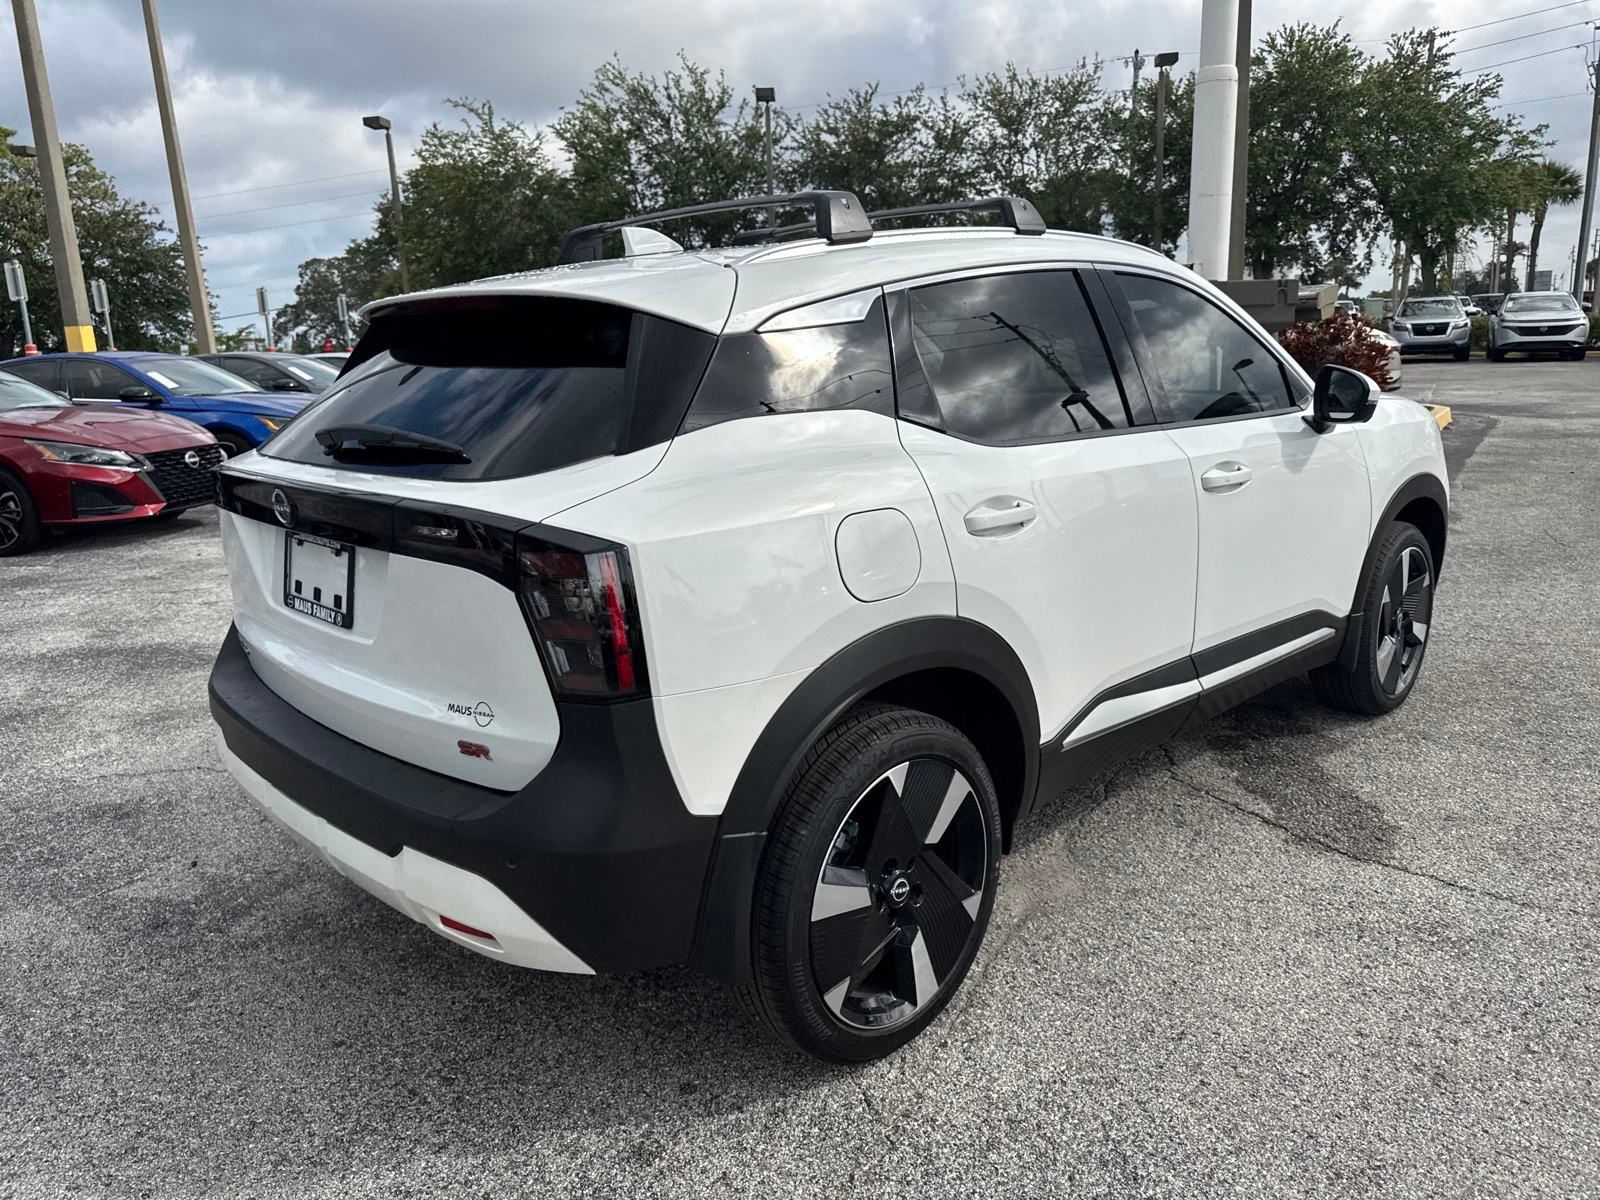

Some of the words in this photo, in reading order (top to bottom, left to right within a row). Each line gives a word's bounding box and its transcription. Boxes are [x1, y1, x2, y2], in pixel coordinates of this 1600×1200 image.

[294, 597, 312, 614] MAUS
[313, 604, 336, 623] FAMILY
[447, 703, 472, 716] MAUS
[473, 710, 495, 718] NISSAN
[457, 740, 493, 761] SR
